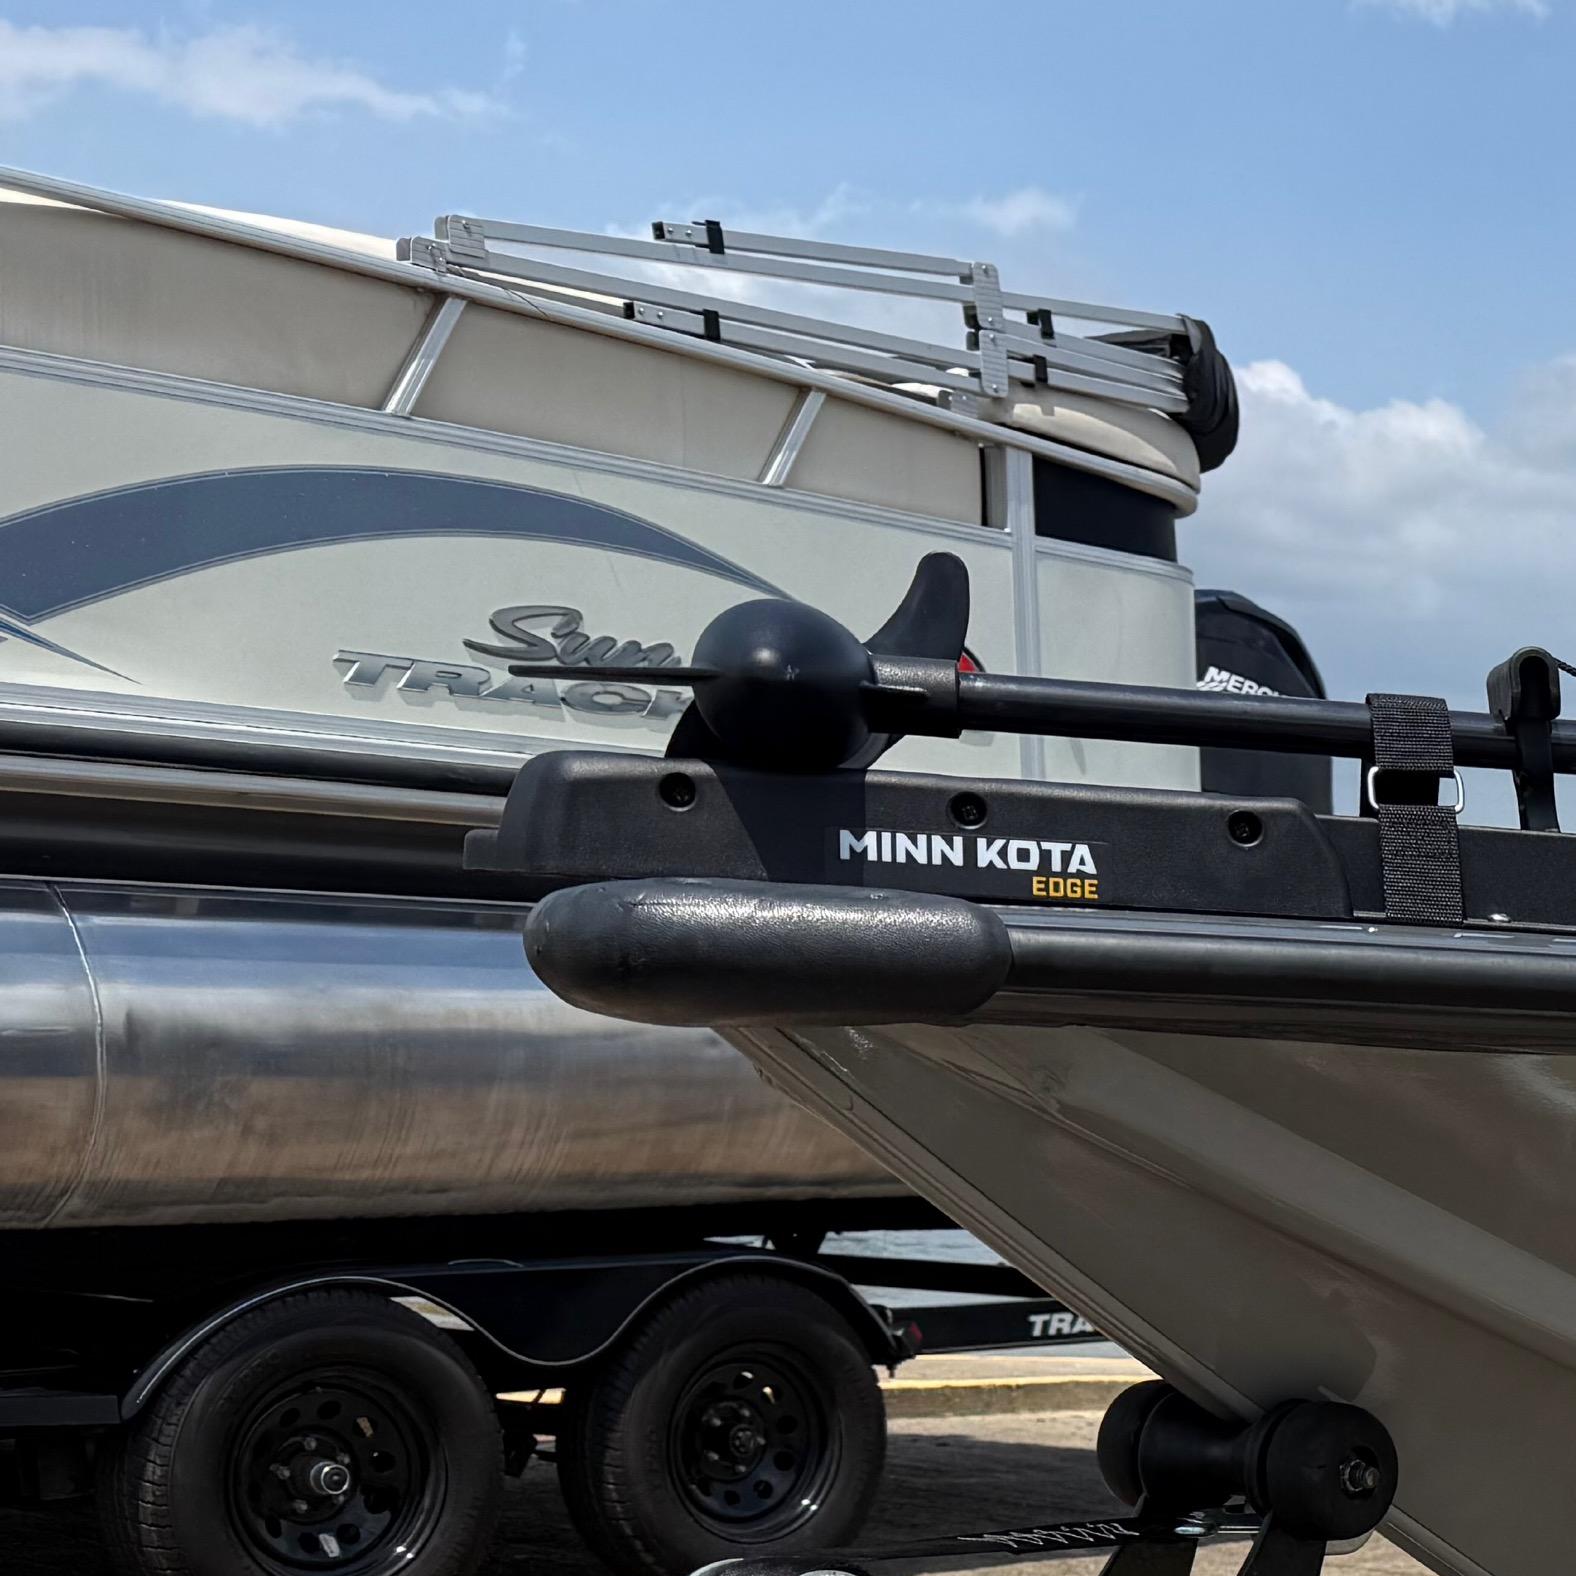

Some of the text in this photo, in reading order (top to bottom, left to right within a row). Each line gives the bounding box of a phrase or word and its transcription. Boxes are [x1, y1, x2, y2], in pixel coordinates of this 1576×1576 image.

[462, 605, 683, 667] Sun
[1203, 666, 1282, 697] MERC
[839, 829, 1098, 875] MINN KOTA
[1032, 876, 1099, 899] EDGE
